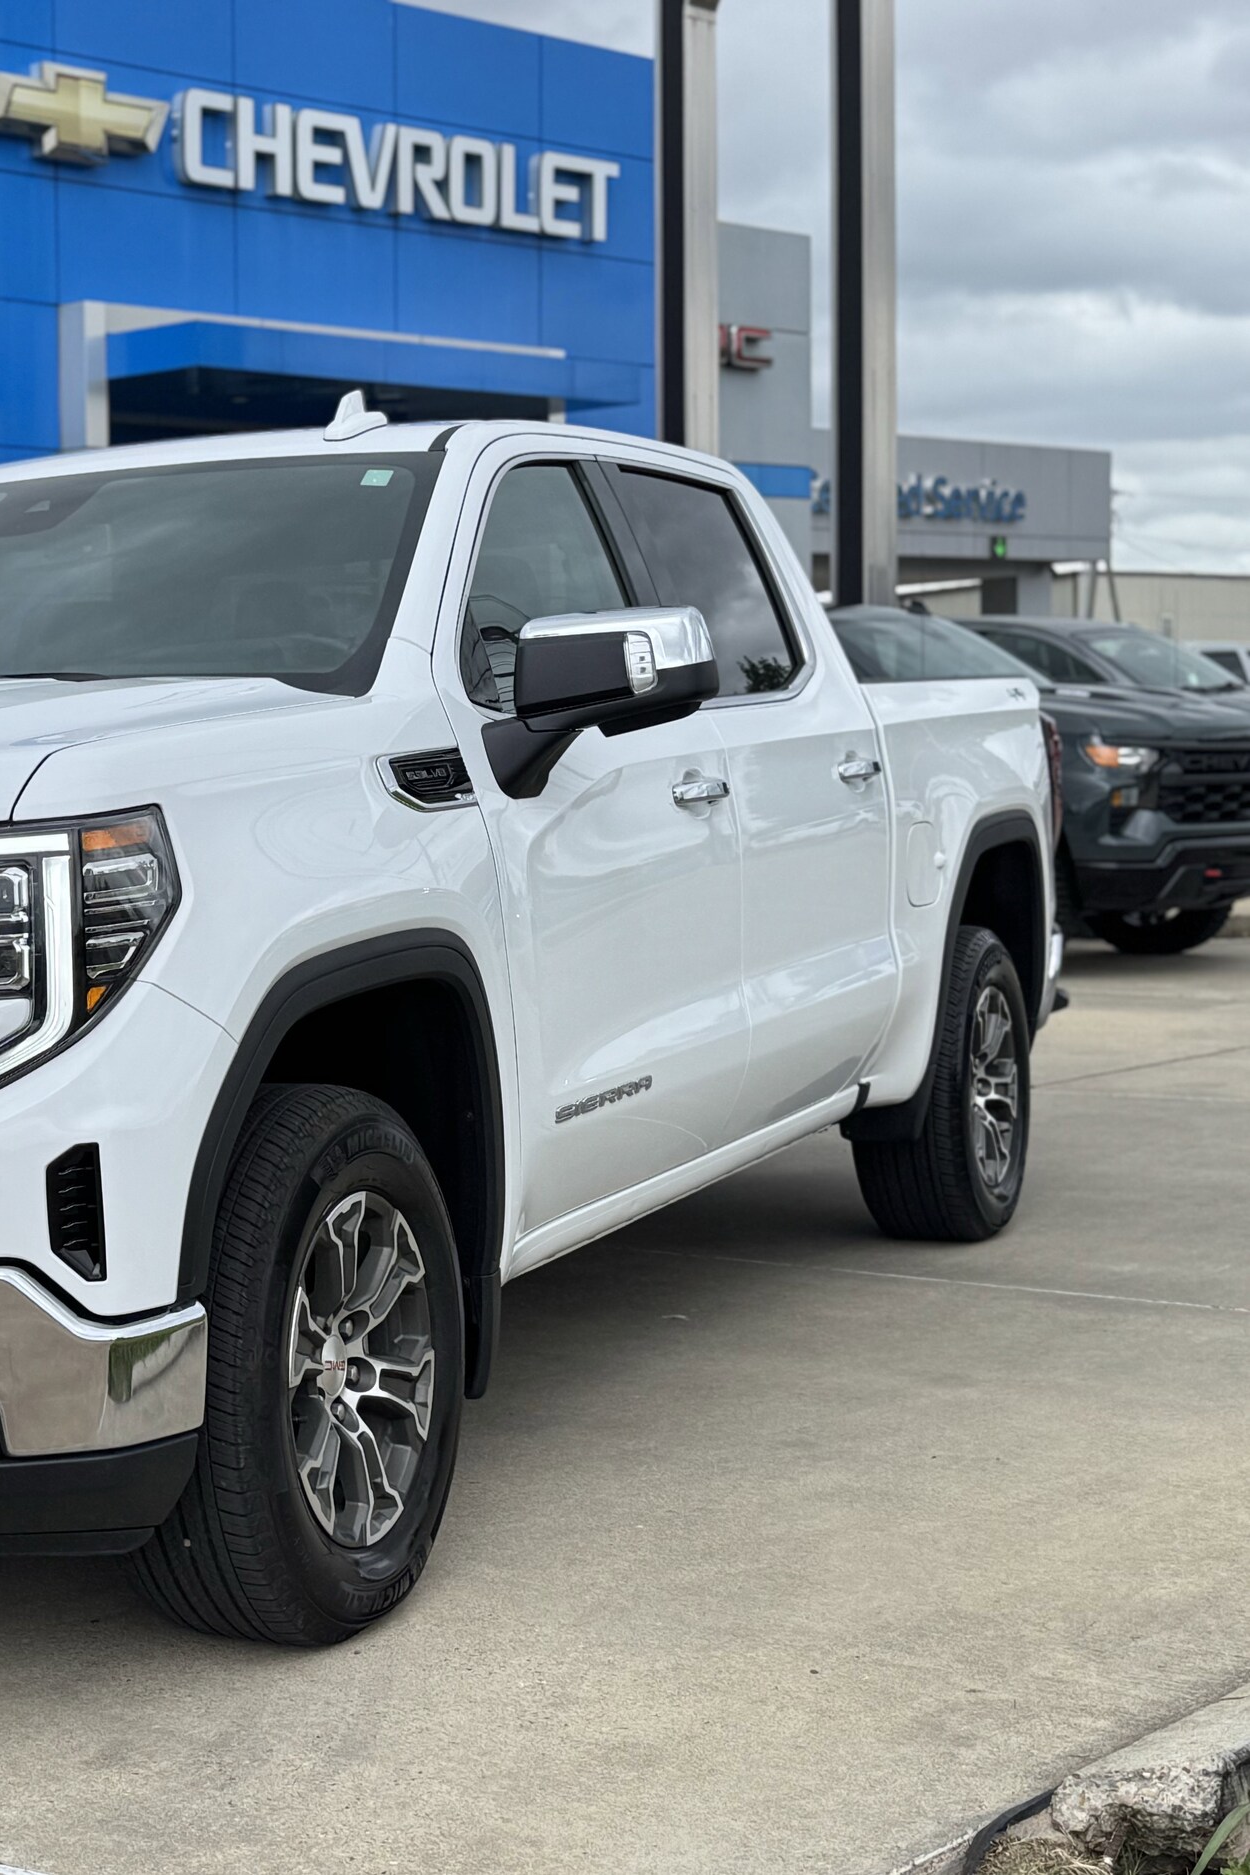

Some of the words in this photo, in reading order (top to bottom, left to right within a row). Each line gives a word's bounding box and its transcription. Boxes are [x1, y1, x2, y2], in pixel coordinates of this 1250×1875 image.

[175, 87, 621, 243] CHEVROLET
[930, 475, 1026, 522] Service
[555, 1074, 652, 1124] SIERRA
[324, 1360, 346, 1371] GMC
